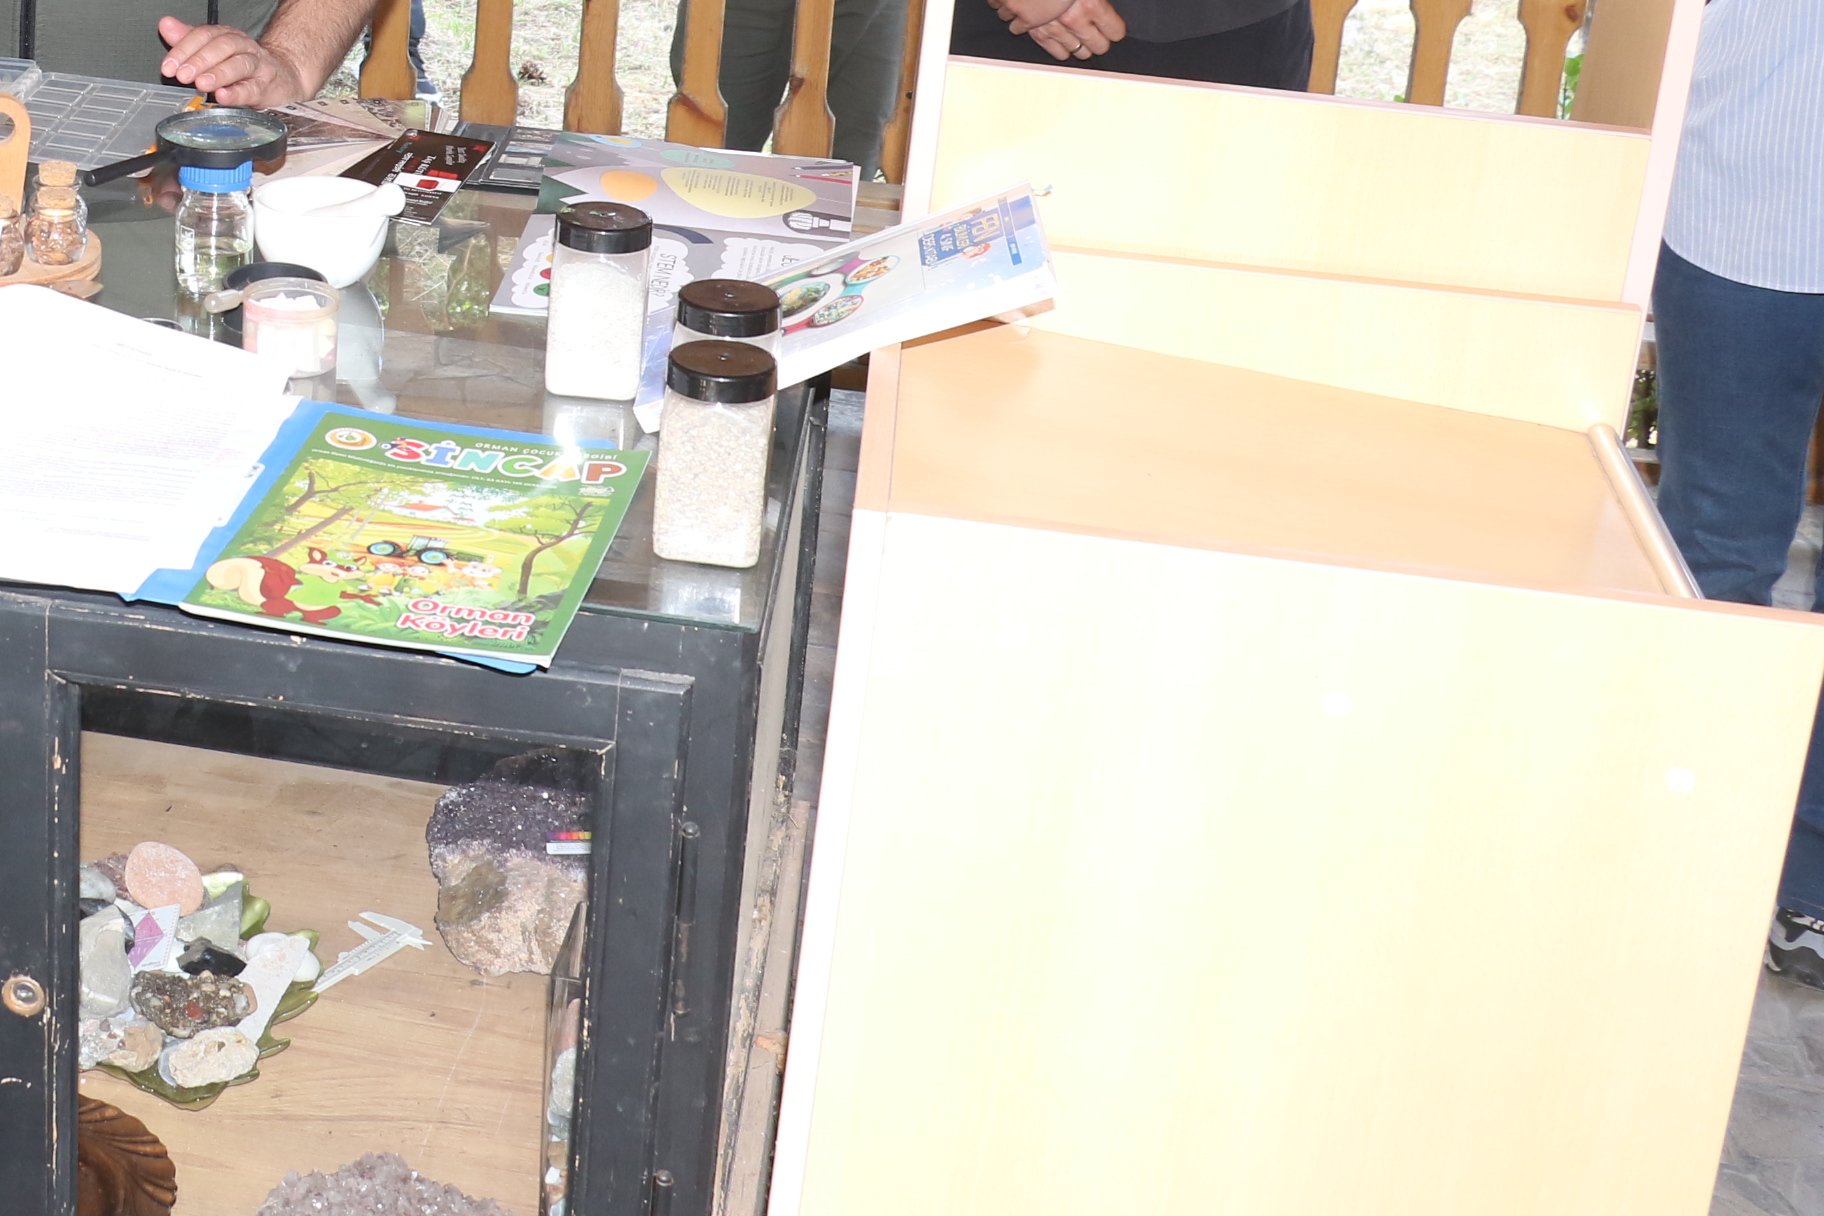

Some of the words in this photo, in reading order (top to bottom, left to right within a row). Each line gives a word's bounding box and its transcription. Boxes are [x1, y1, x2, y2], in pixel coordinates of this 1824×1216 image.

[654, 253, 678, 276] STEM
[389, 436, 627, 485] SİNCAP
[475, 441, 518, 453] ORMAN
[407, 598, 535, 626] Orman
[396, 613, 530, 642] Köyleri
